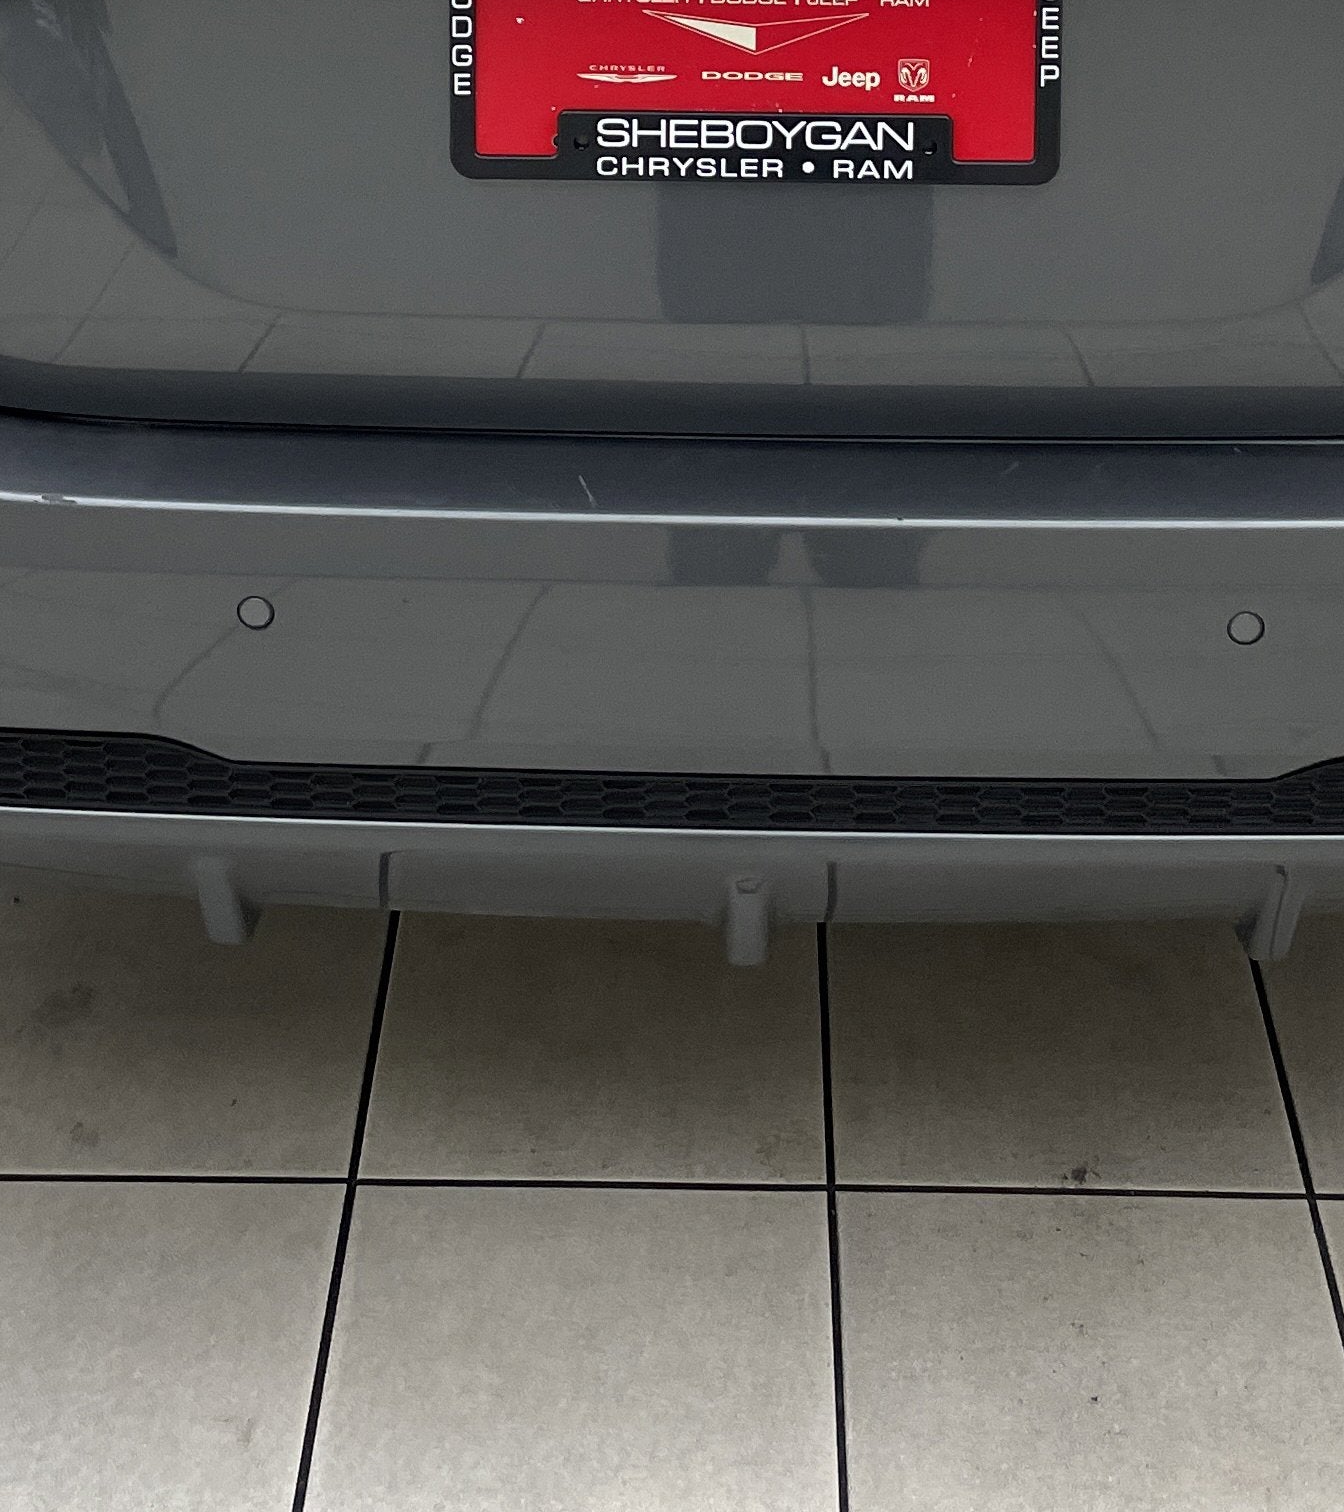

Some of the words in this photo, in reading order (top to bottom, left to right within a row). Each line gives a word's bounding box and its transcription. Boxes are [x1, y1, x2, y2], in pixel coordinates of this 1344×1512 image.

[588, 64, 666, 72] CHRYSLER
[701, 70, 804, 82] DODGE
[821, 65, 881, 92] Jeep
[893, 94, 936, 103] RAM
[596, 117, 914, 151] SHEBOYGAN
[596, 156, 784, 178] CHRYSLER
[833, 159, 913, 180] RAM
